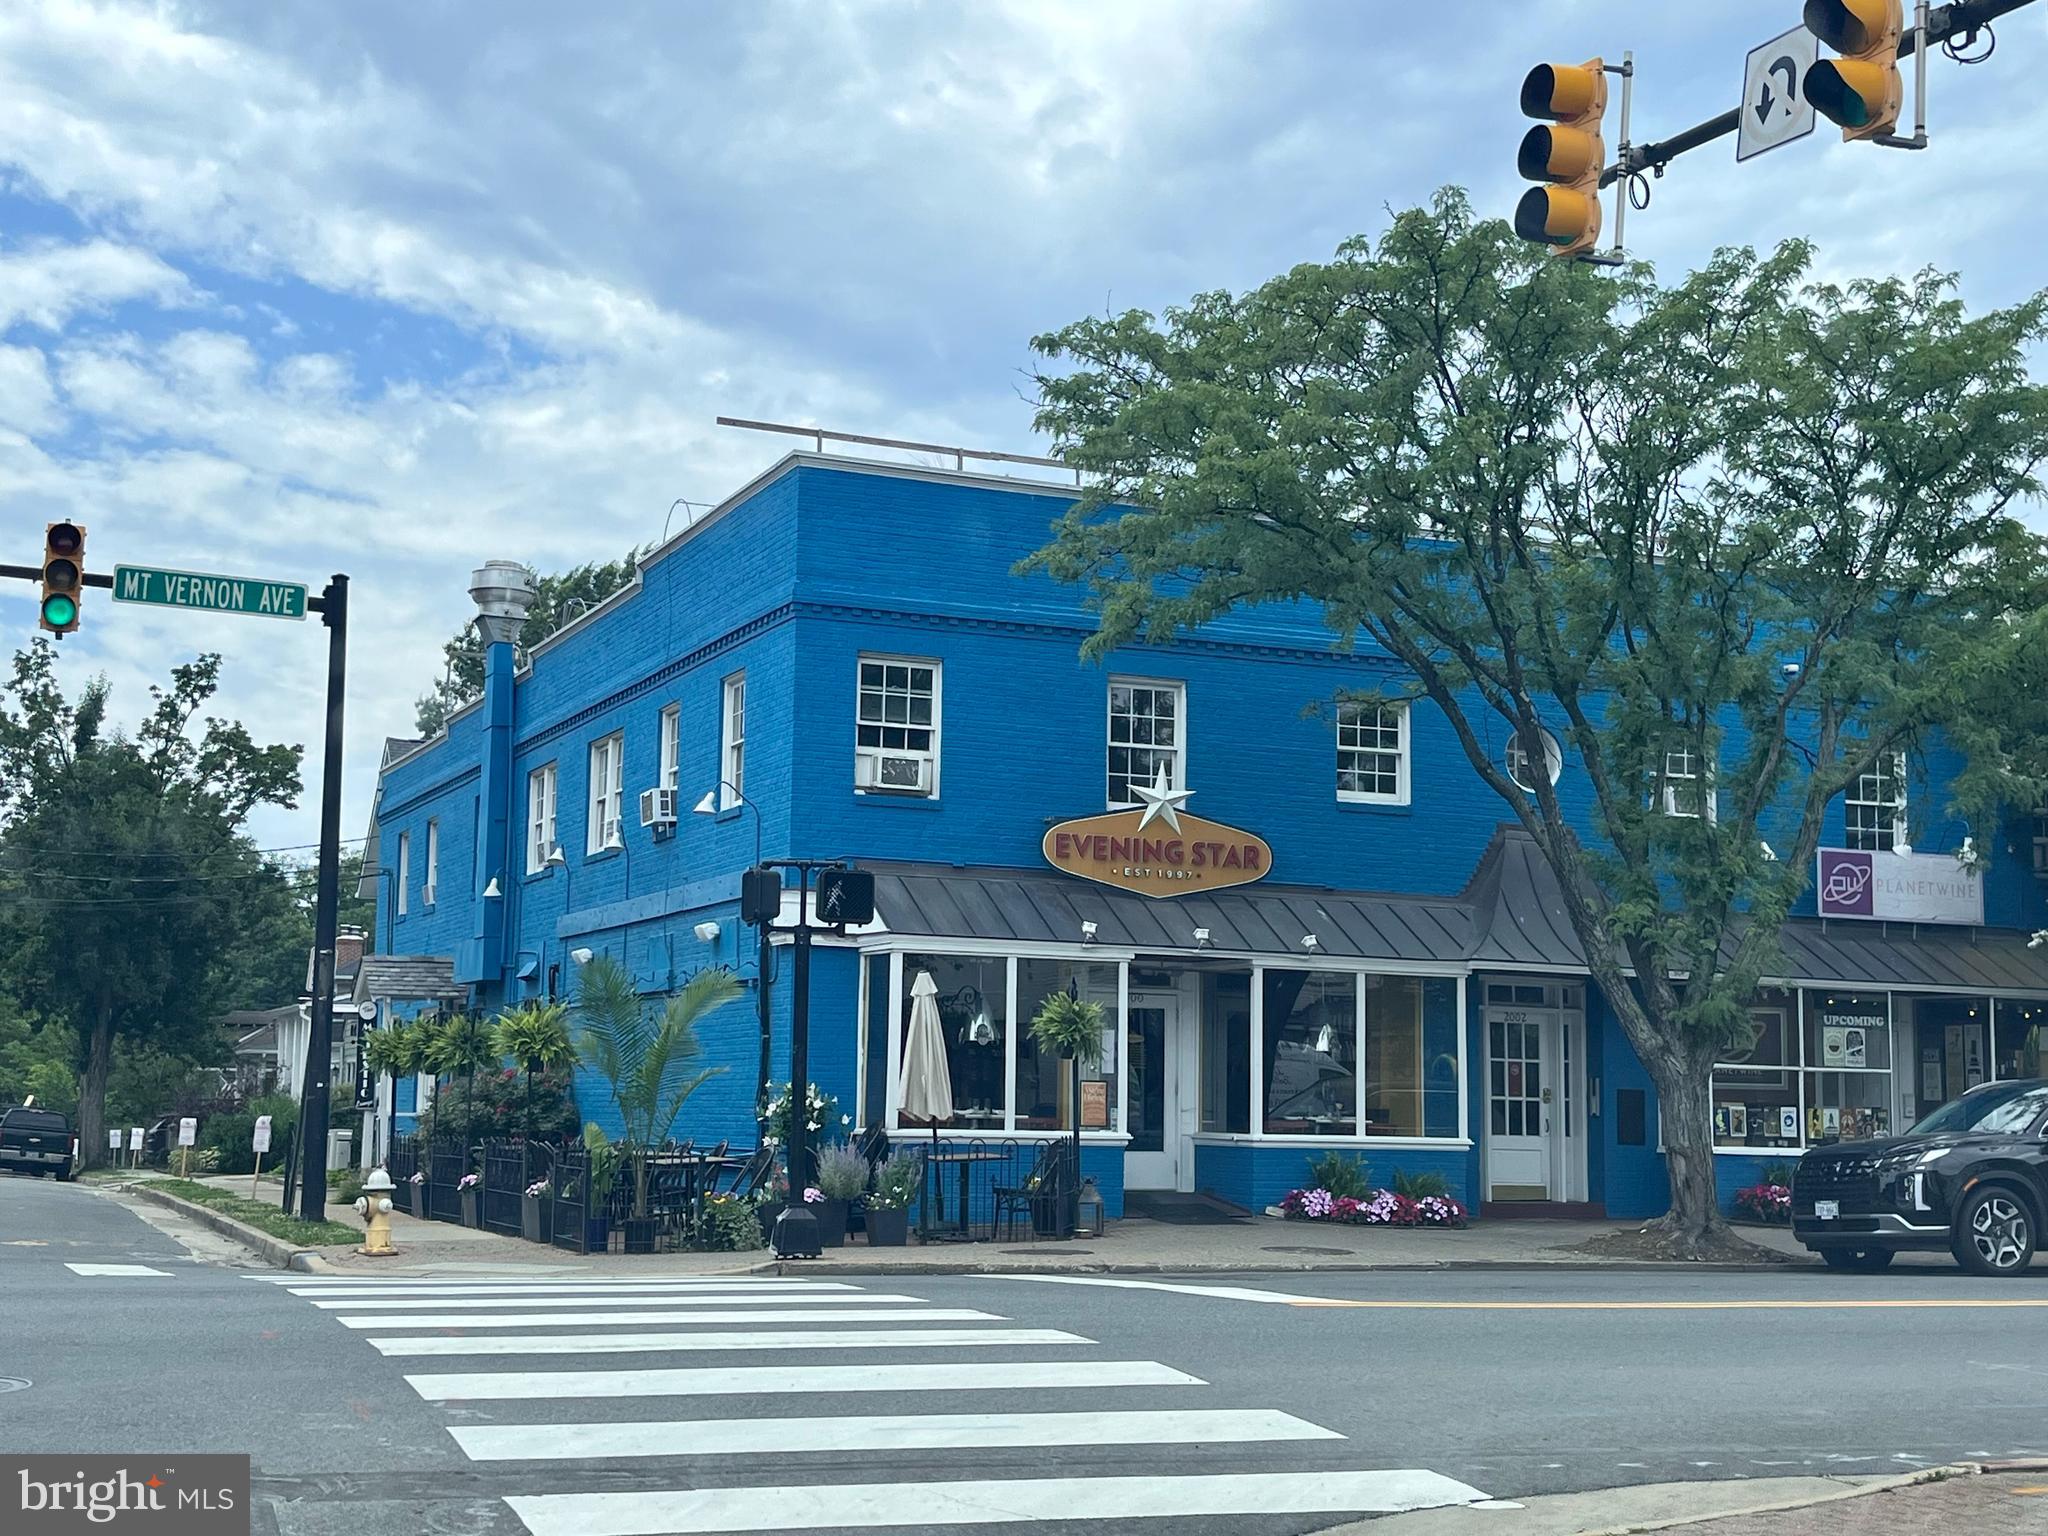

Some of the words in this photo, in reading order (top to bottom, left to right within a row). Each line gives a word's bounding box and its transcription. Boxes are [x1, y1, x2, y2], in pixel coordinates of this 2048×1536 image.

[124, 571, 152, 600] MT
[164, 575, 245, 610] VERNON
[259, 587, 296, 615] AVE
[1055, 833, 1184, 865] EVENING
[1191, 841, 1260, 870] STAR
[1124, 867, 1151, 878] EST
[1157, 869, 1193, 880] 1997
[1876, 878, 1975, 899] PLANETWINE
[1504, 1012, 1527, 1022] 2002
[1823, 1014, 1885, 1027] UPCOMING
